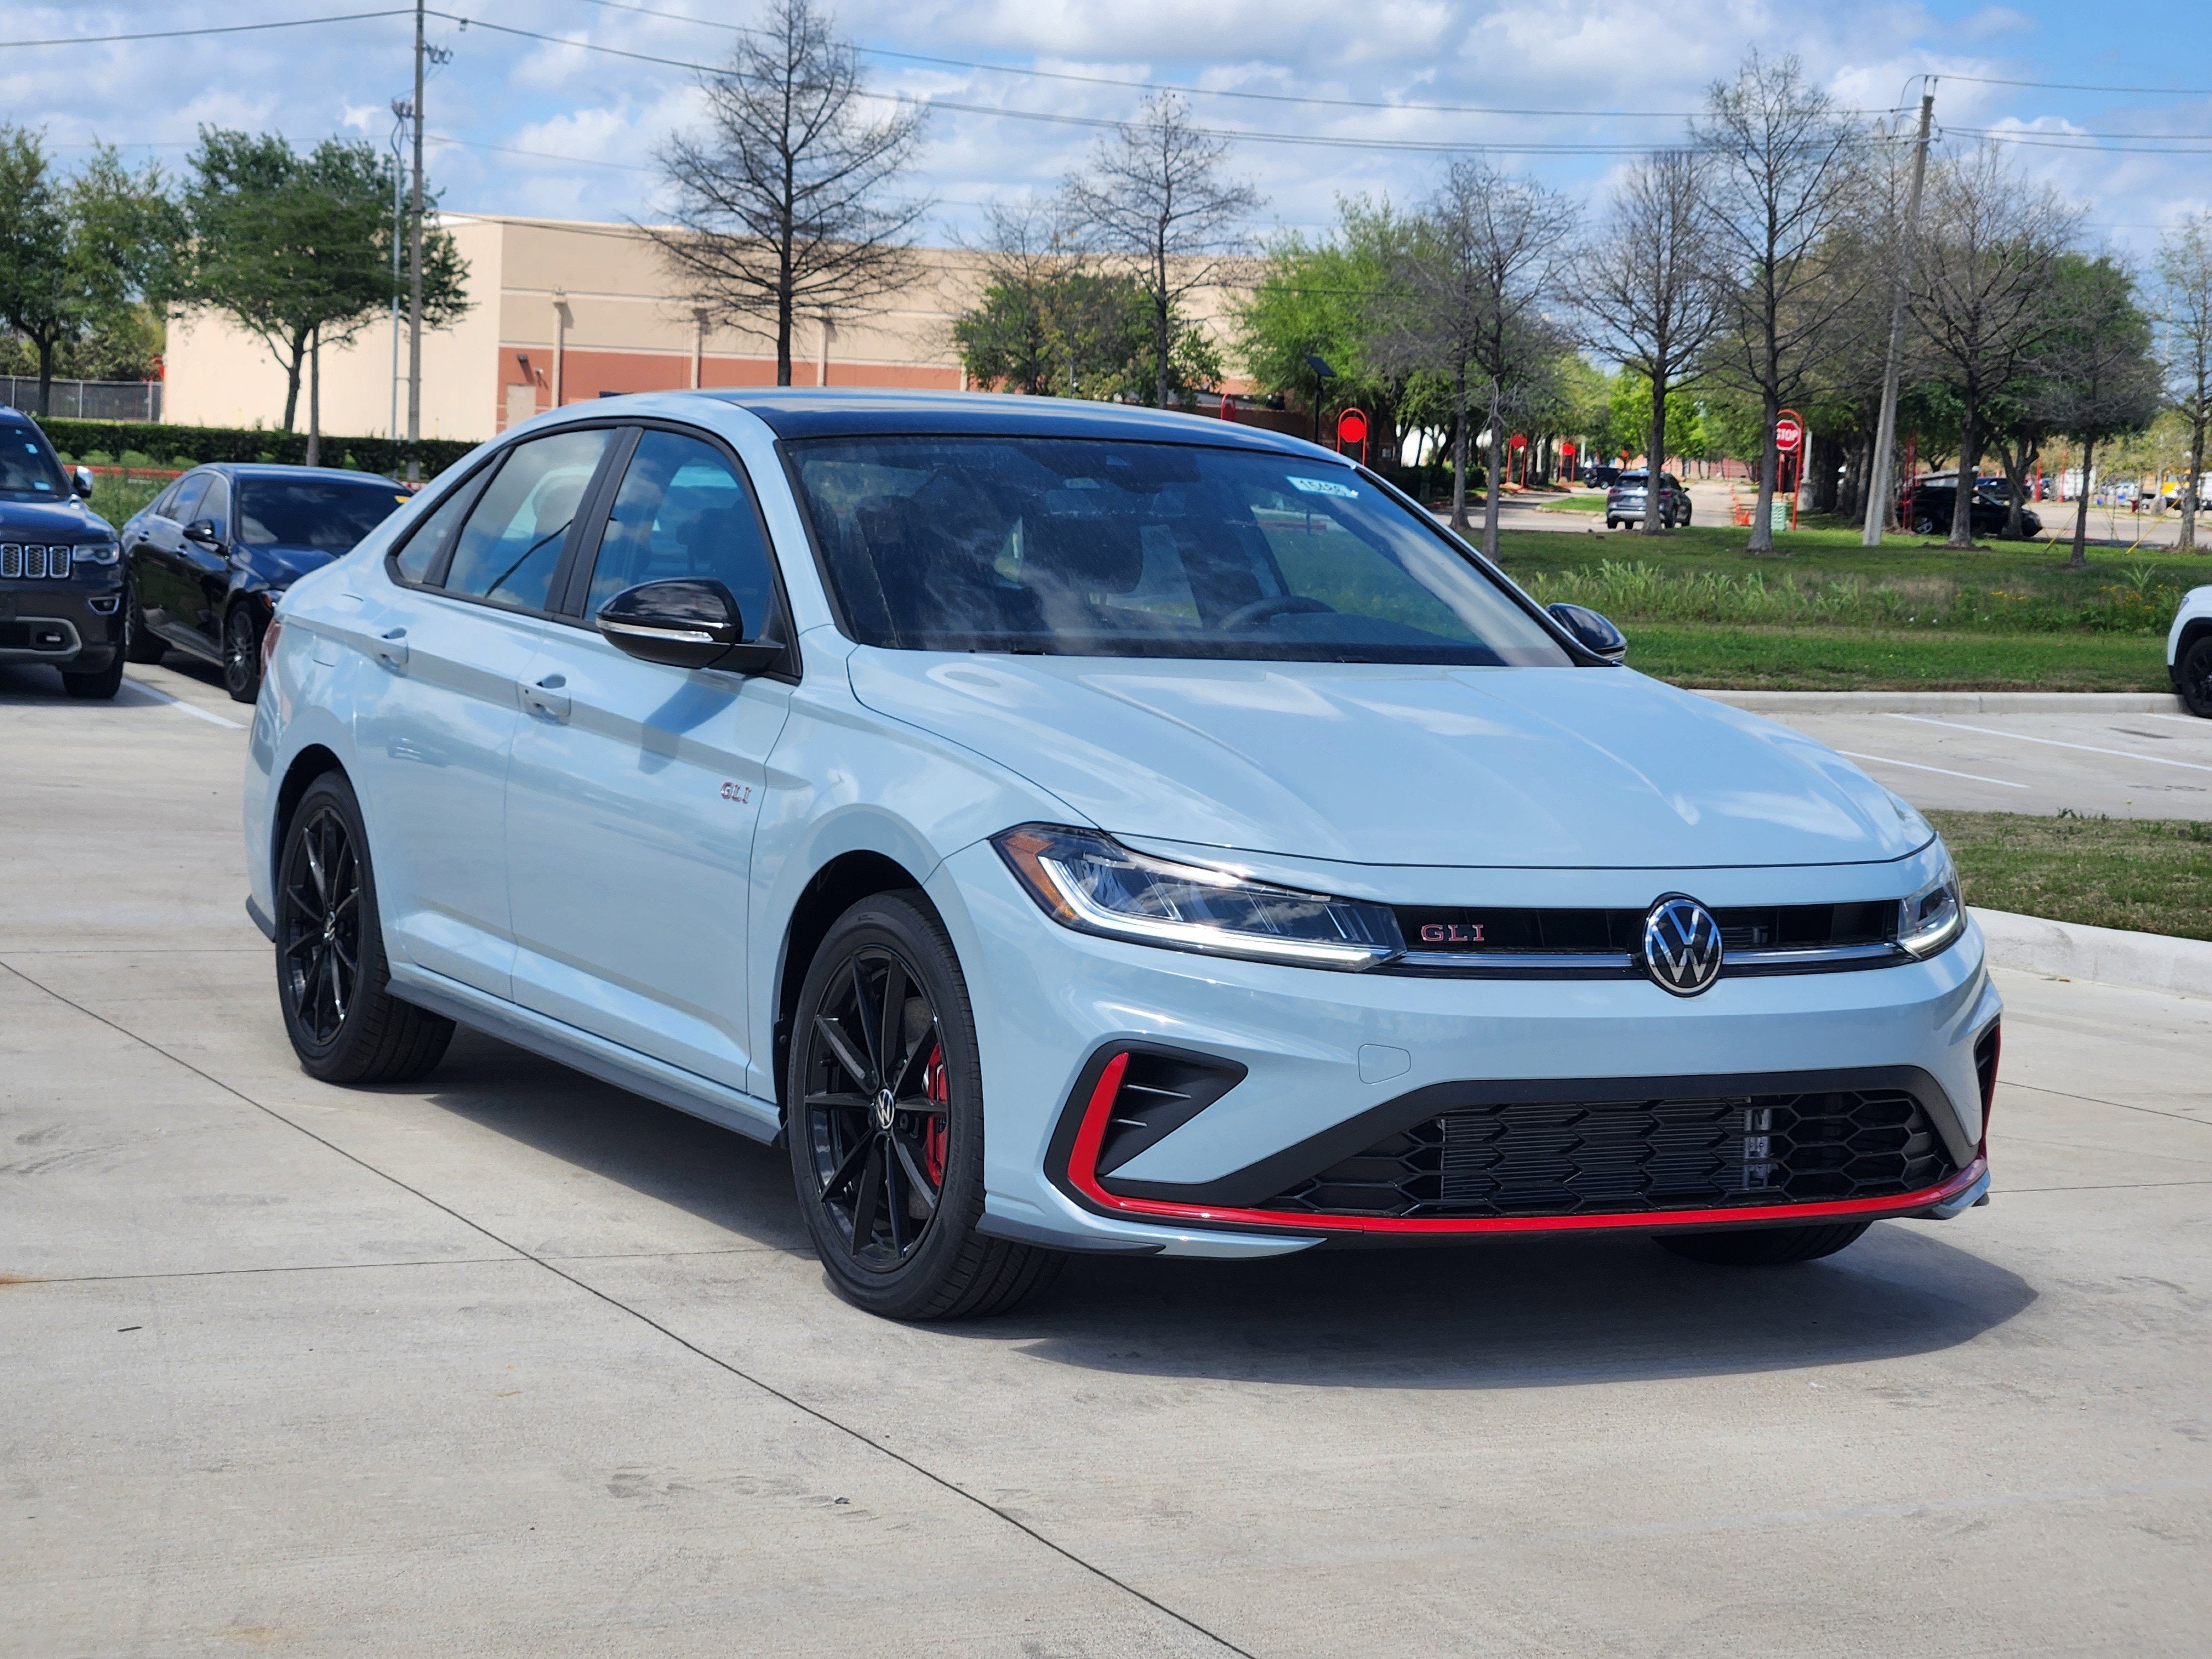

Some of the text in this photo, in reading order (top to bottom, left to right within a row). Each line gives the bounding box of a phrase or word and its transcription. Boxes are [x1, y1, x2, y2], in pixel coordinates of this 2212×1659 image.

[1776, 427, 1799, 441] STOP
[721, 781, 752, 804] GLI
[1421, 924, 1485, 941] GLI
